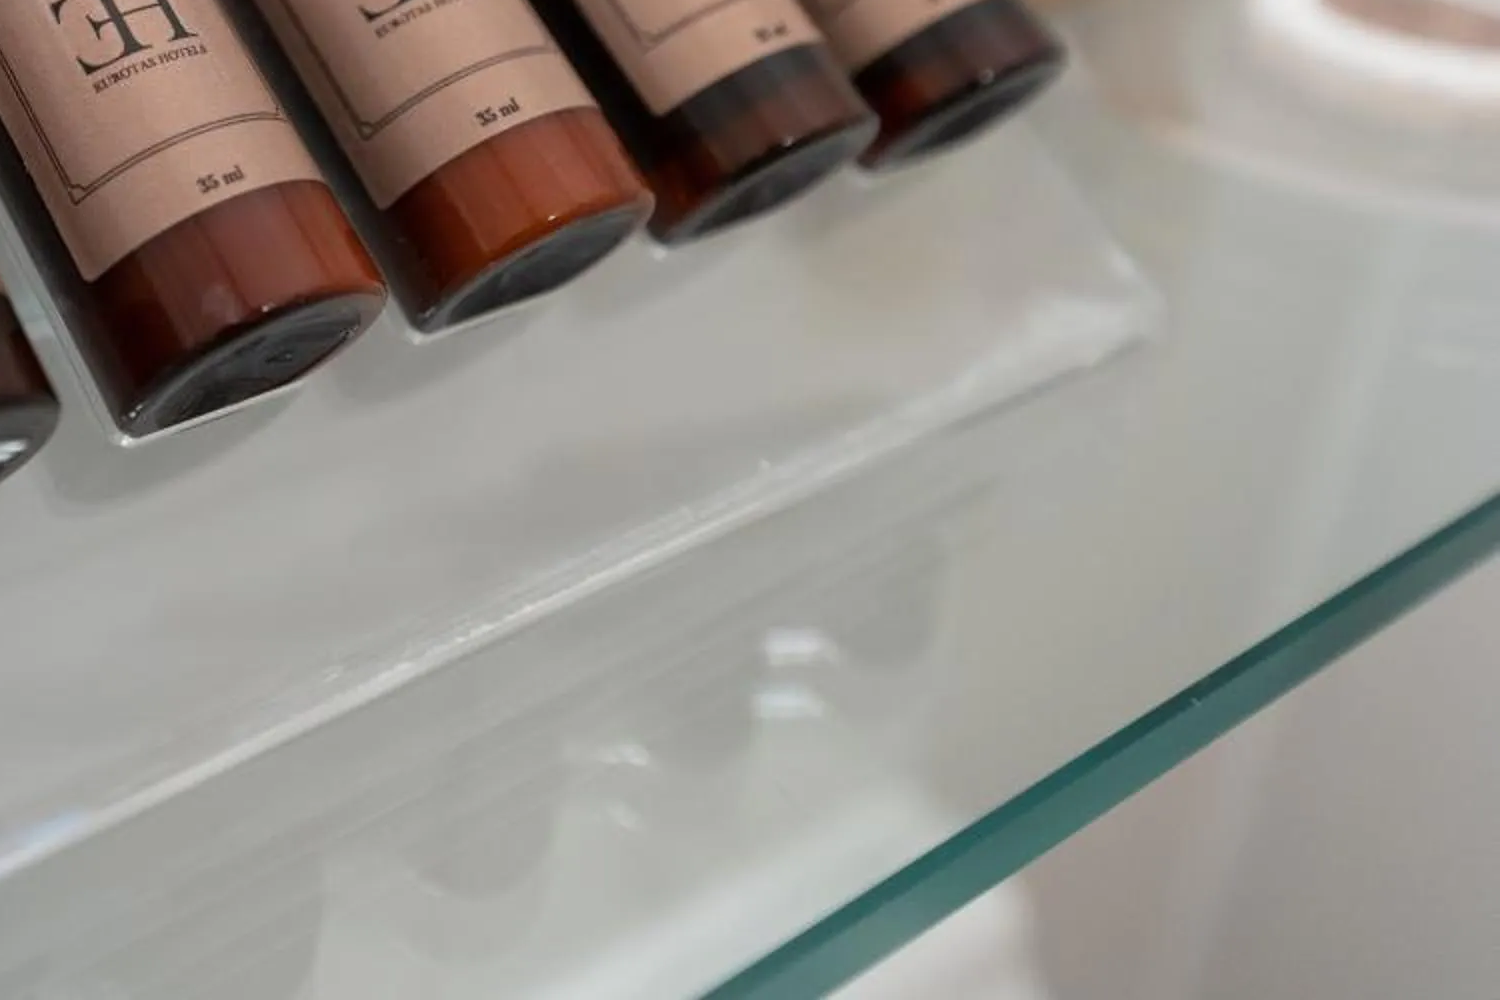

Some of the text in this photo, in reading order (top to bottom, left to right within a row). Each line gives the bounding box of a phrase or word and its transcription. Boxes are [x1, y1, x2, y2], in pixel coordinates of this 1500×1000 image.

[92, 43, 208, 94] EUROTAS HOTELS
[499, 96, 520, 117] ml
[196, 164, 245, 193] 35 ml
